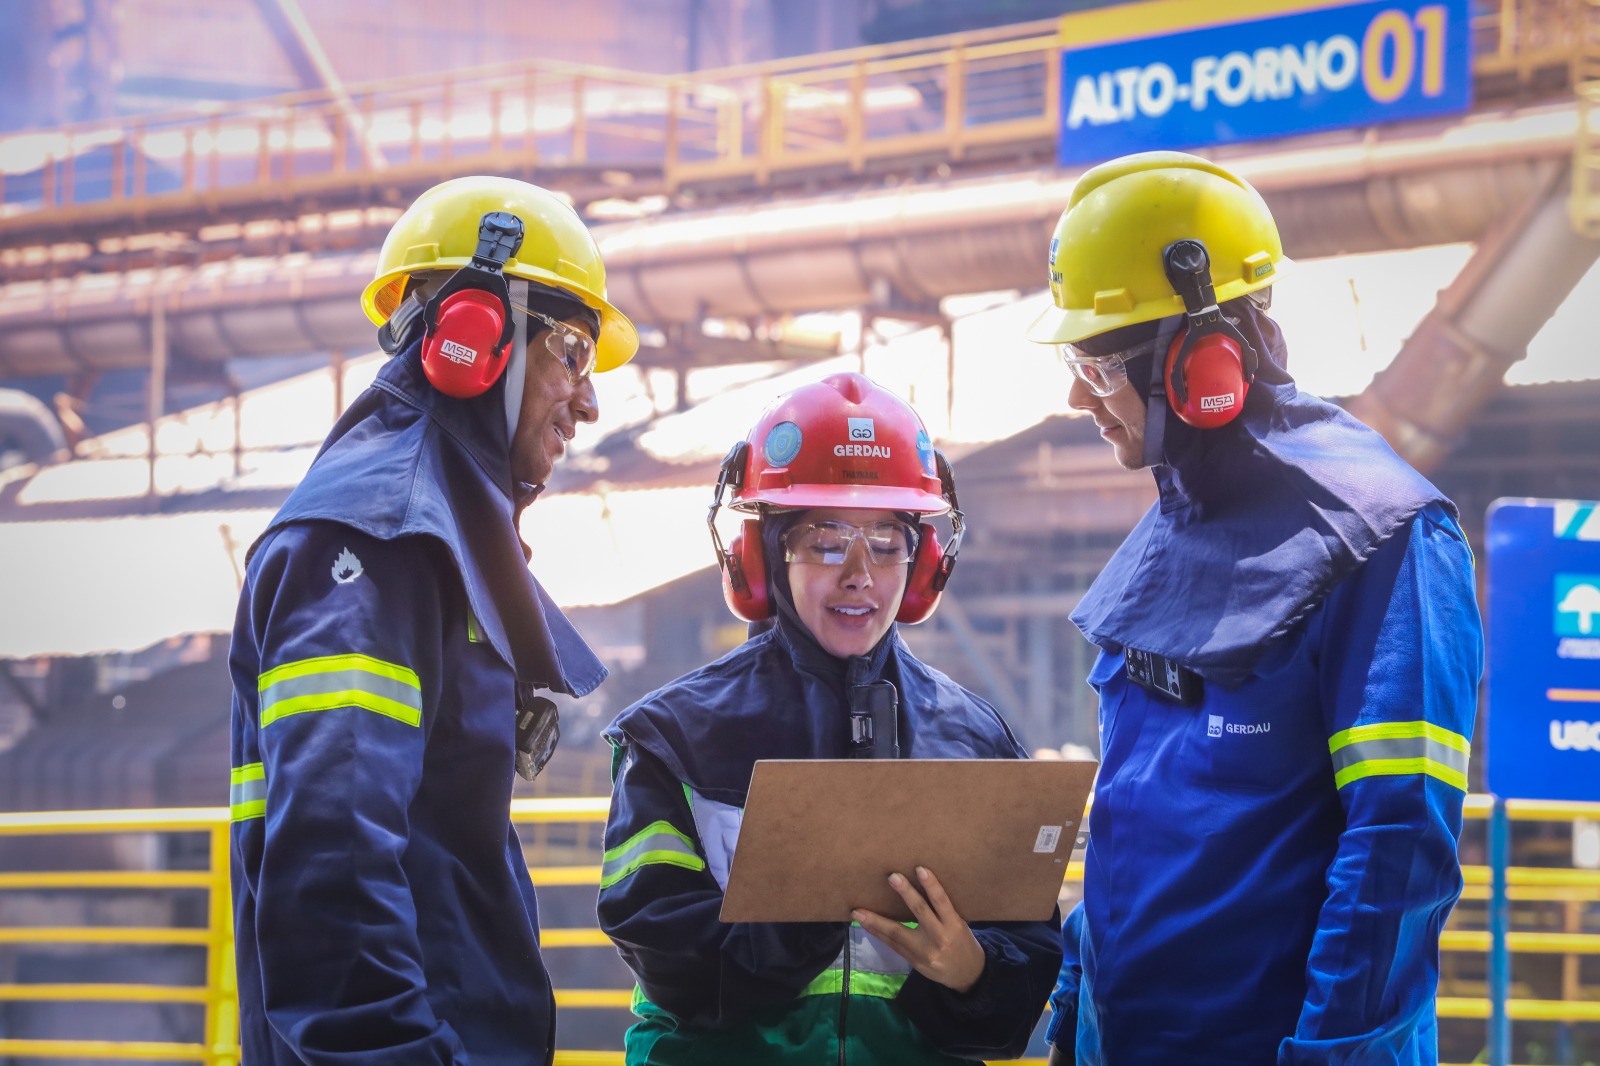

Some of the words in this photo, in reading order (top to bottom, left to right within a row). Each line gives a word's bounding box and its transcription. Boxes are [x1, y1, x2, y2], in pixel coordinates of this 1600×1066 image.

[1067, 34, 1358, 129] ALTO-FORNO
[1363, 5, 1448, 103] 01
[1256, 263, 1272, 277] MSA
[443, 342, 473, 361] MSA
[1203, 395, 1233, 407] MSA
[833, 444, 891, 459] GERDAU
[1225, 722, 1271, 735] GERDAU
